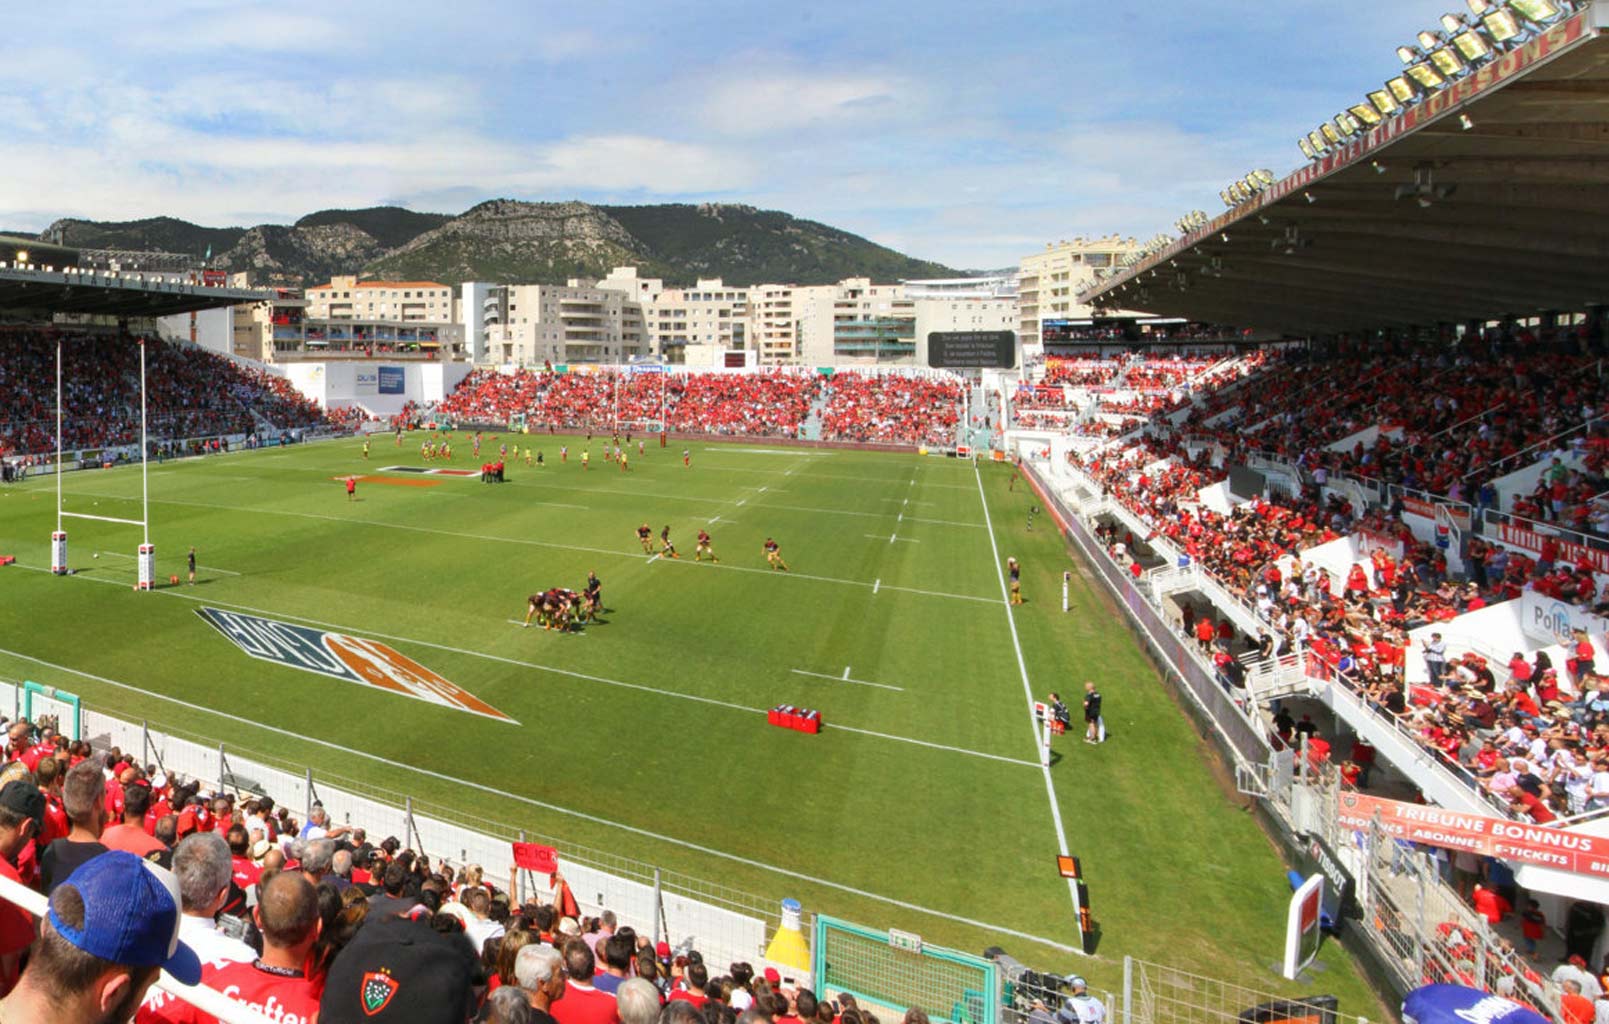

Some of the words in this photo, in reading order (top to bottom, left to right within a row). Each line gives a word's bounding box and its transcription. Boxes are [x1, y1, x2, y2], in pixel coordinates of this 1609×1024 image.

[1416, 24, 1567, 121] BOISSONS
[1395, 805, 1486, 833] TRIBUNE
[1492, 823, 1592, 851] BONNUS
[1317, 847, 1346, 890] TISSOT
[1494, 844, 1568, 865] E-TICKETS
